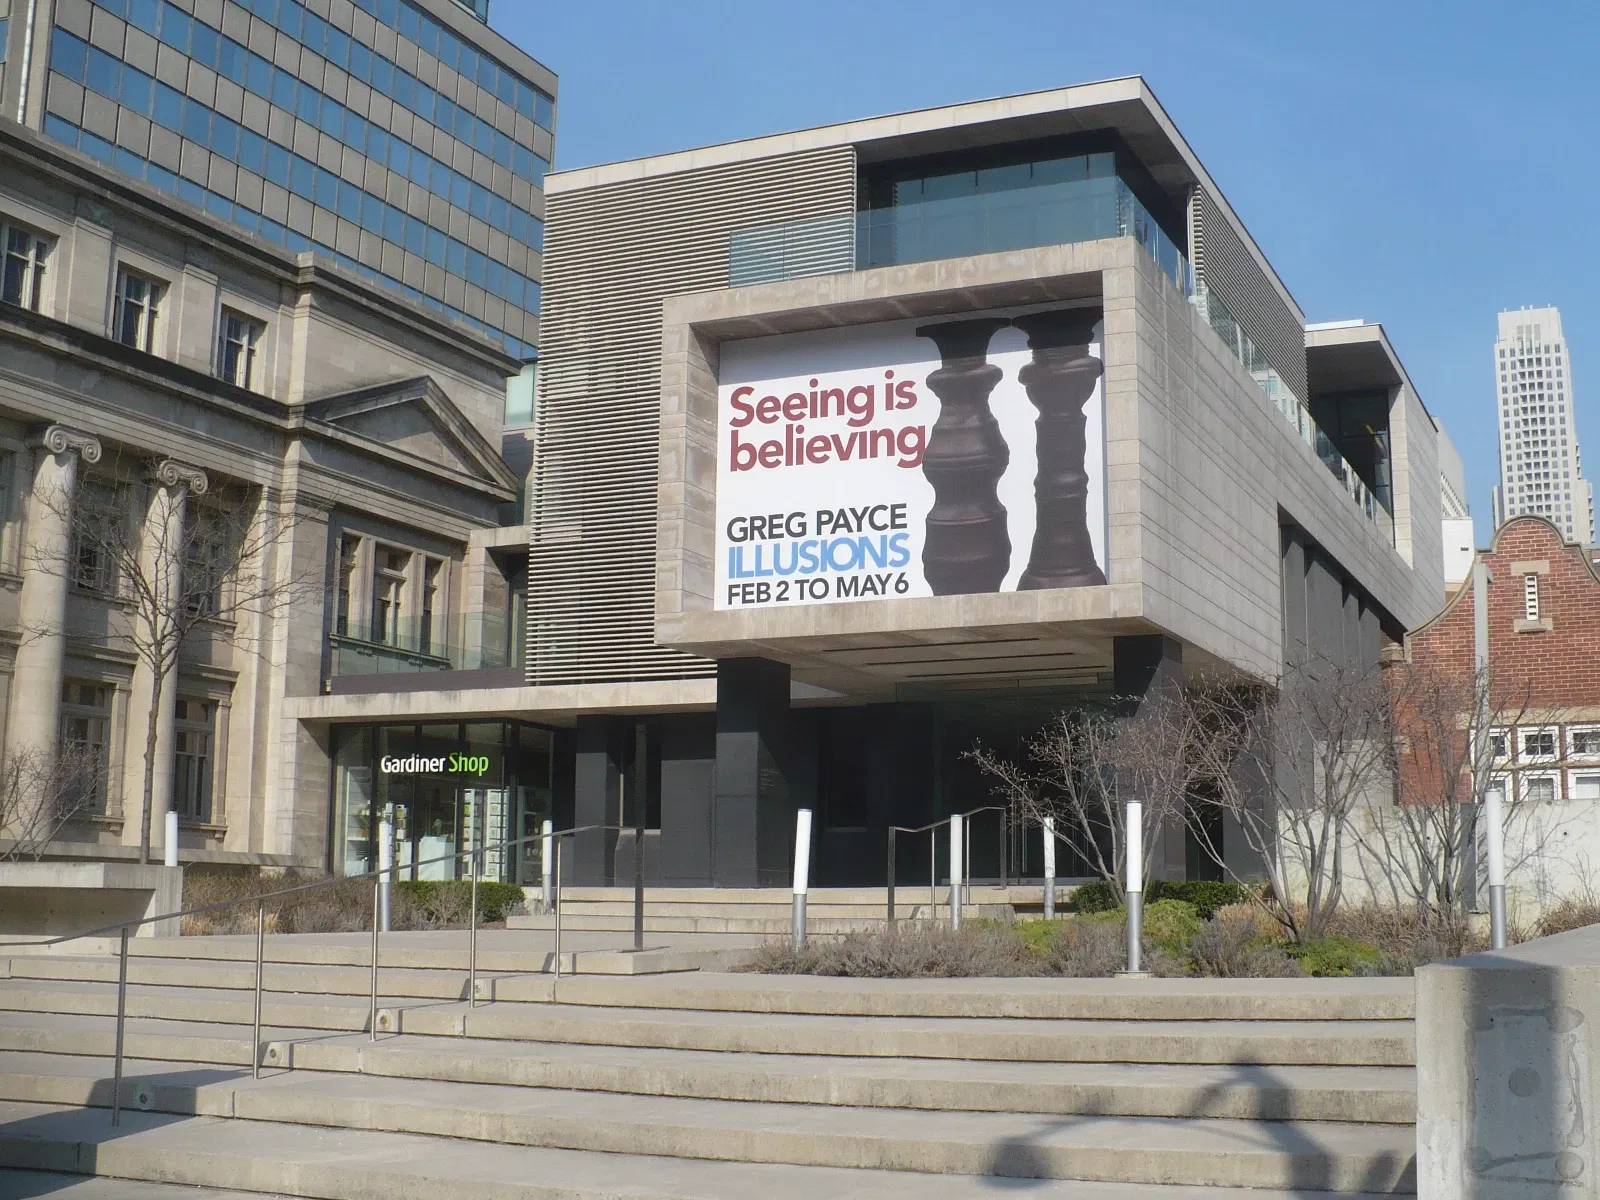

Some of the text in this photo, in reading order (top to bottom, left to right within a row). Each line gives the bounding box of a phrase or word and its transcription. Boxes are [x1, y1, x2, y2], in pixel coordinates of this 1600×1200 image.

[729, 370, 918, 428] Seeing is
[730, 424, 926, 472] believing
[726, 503, 908, 543] GREG PAYCE
[727, 532, 911, 579] ILLUSIONS
[727, 571, 909, 605] FEB 2 TO MAY 6
[381, 752, 489, 777] Gardiner Shop
